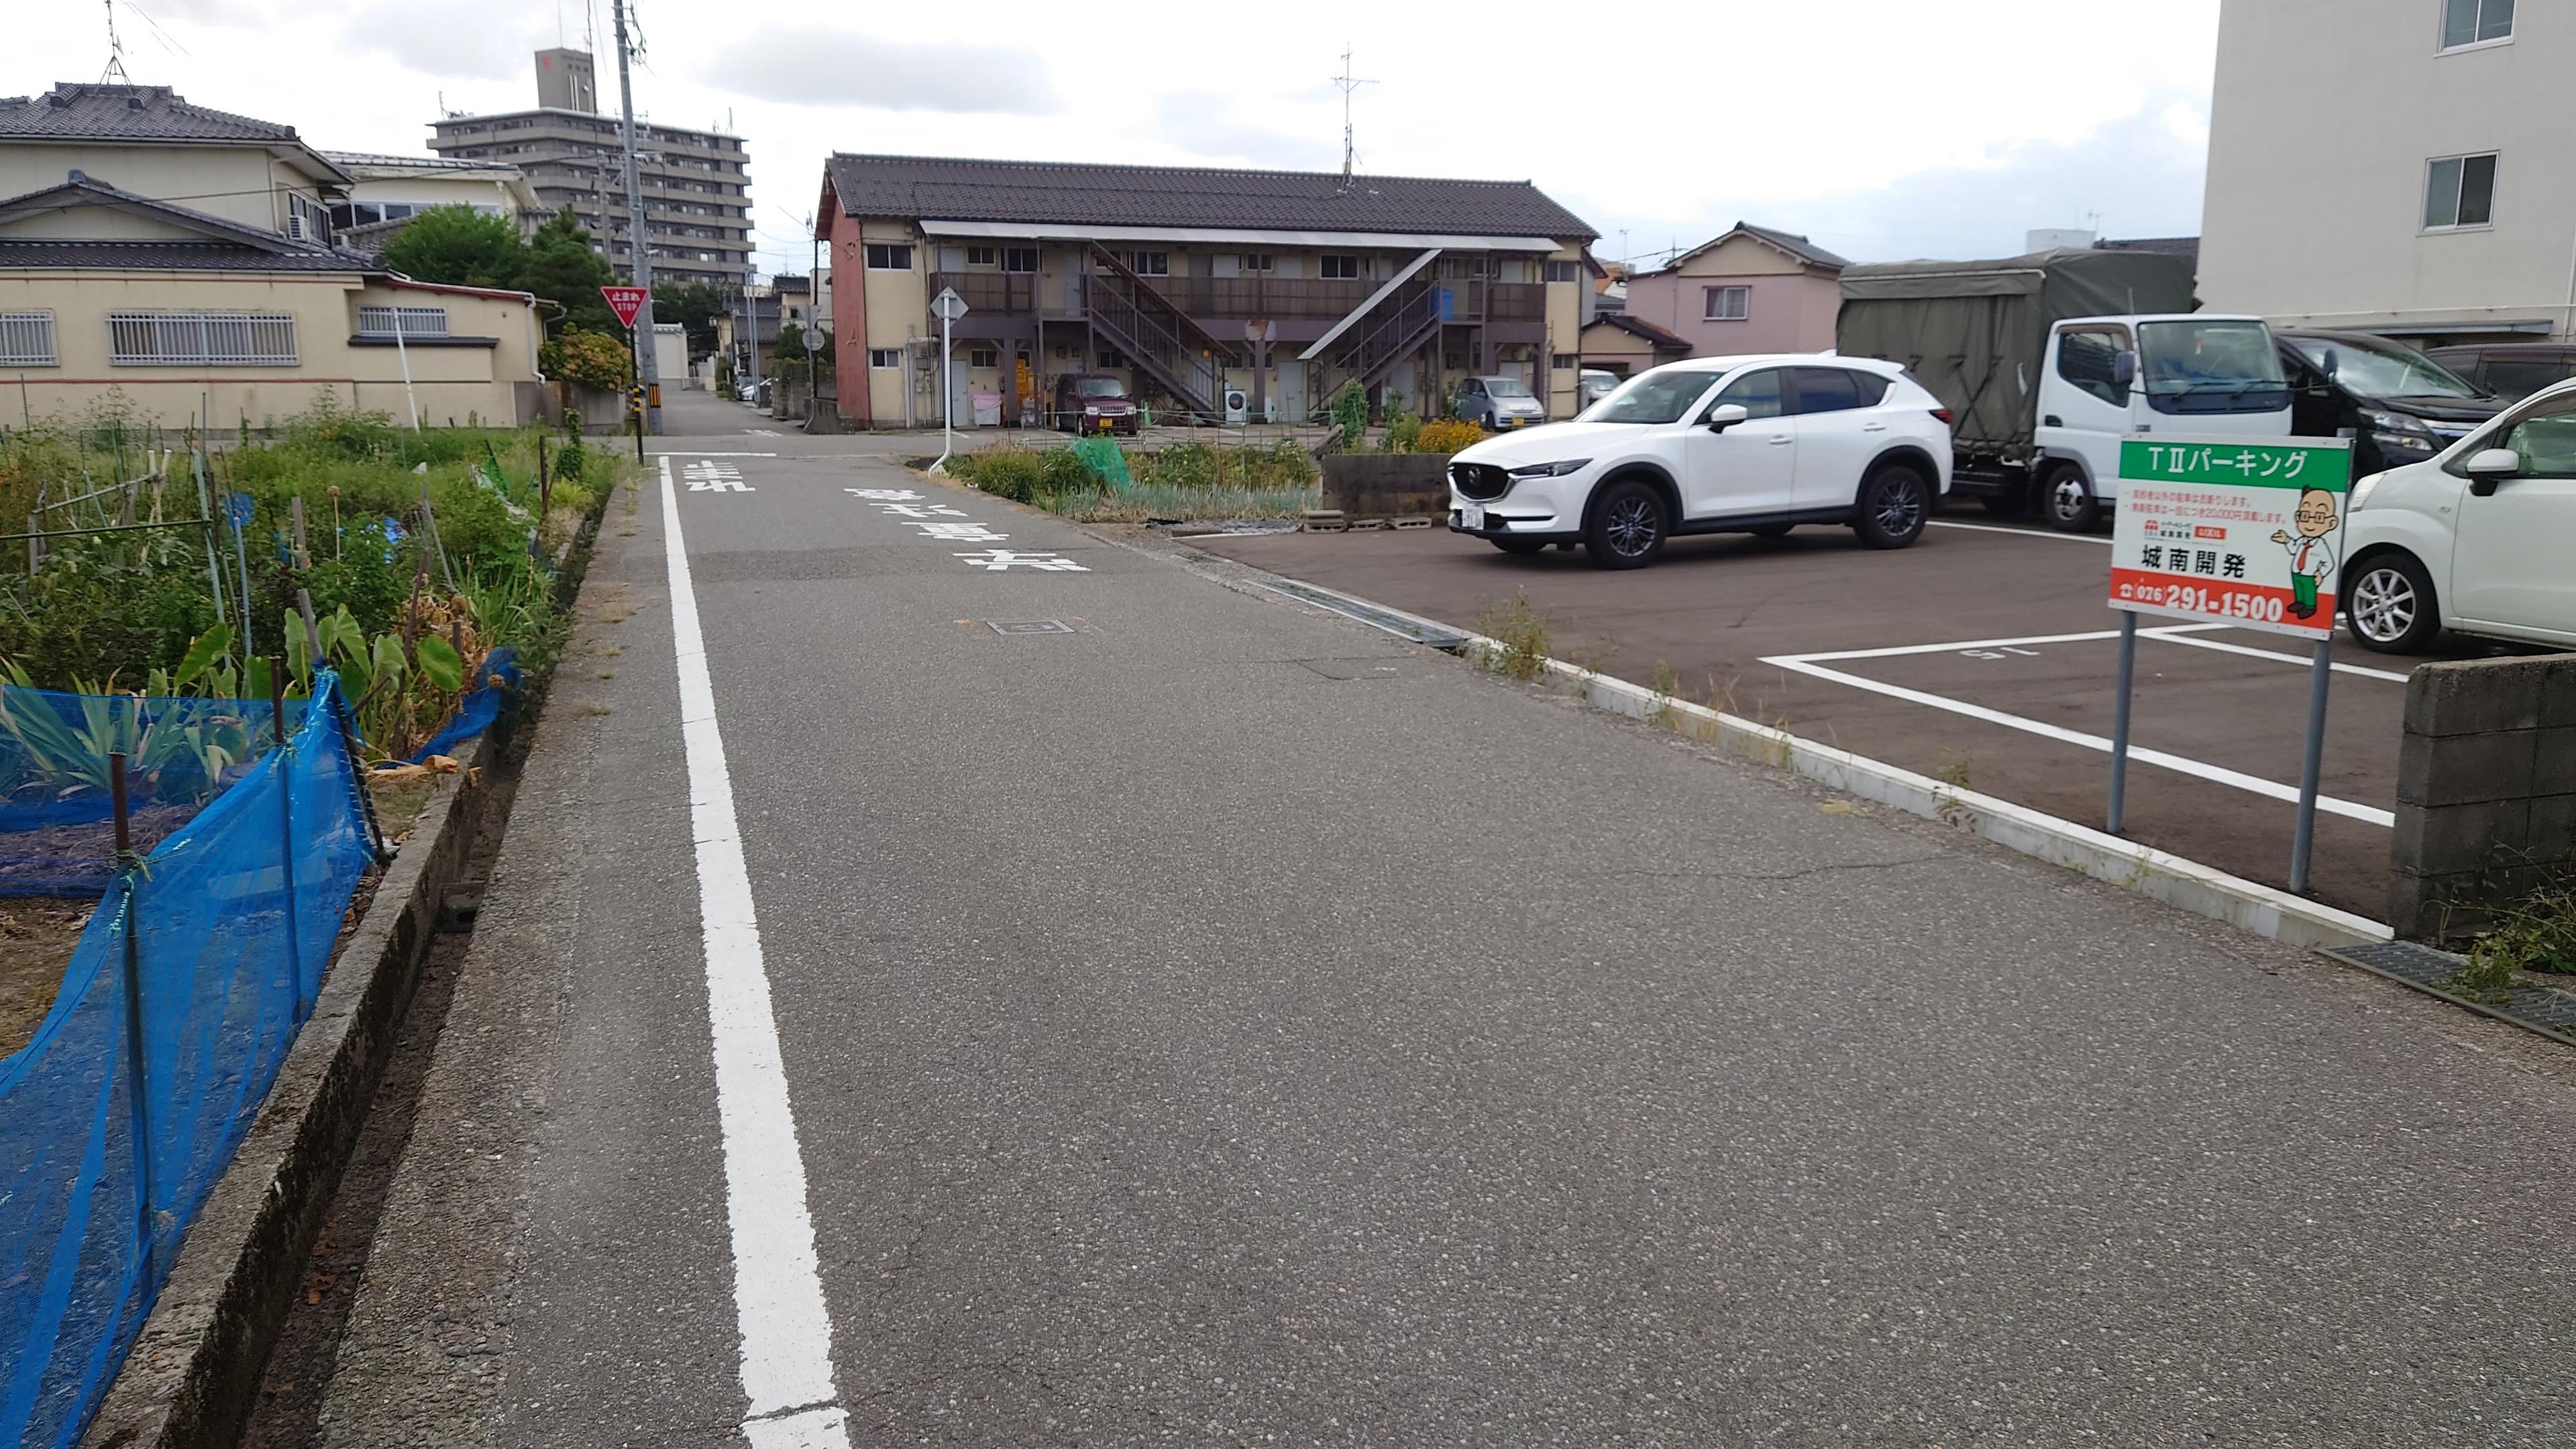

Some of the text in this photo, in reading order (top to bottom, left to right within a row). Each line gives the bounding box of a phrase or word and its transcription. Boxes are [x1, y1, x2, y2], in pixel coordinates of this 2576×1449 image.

[612, 291, 640, 301] 止まれ
[616, 303, 637, 311] STOP
[2141, 545, 2246, 578] 城南開発
